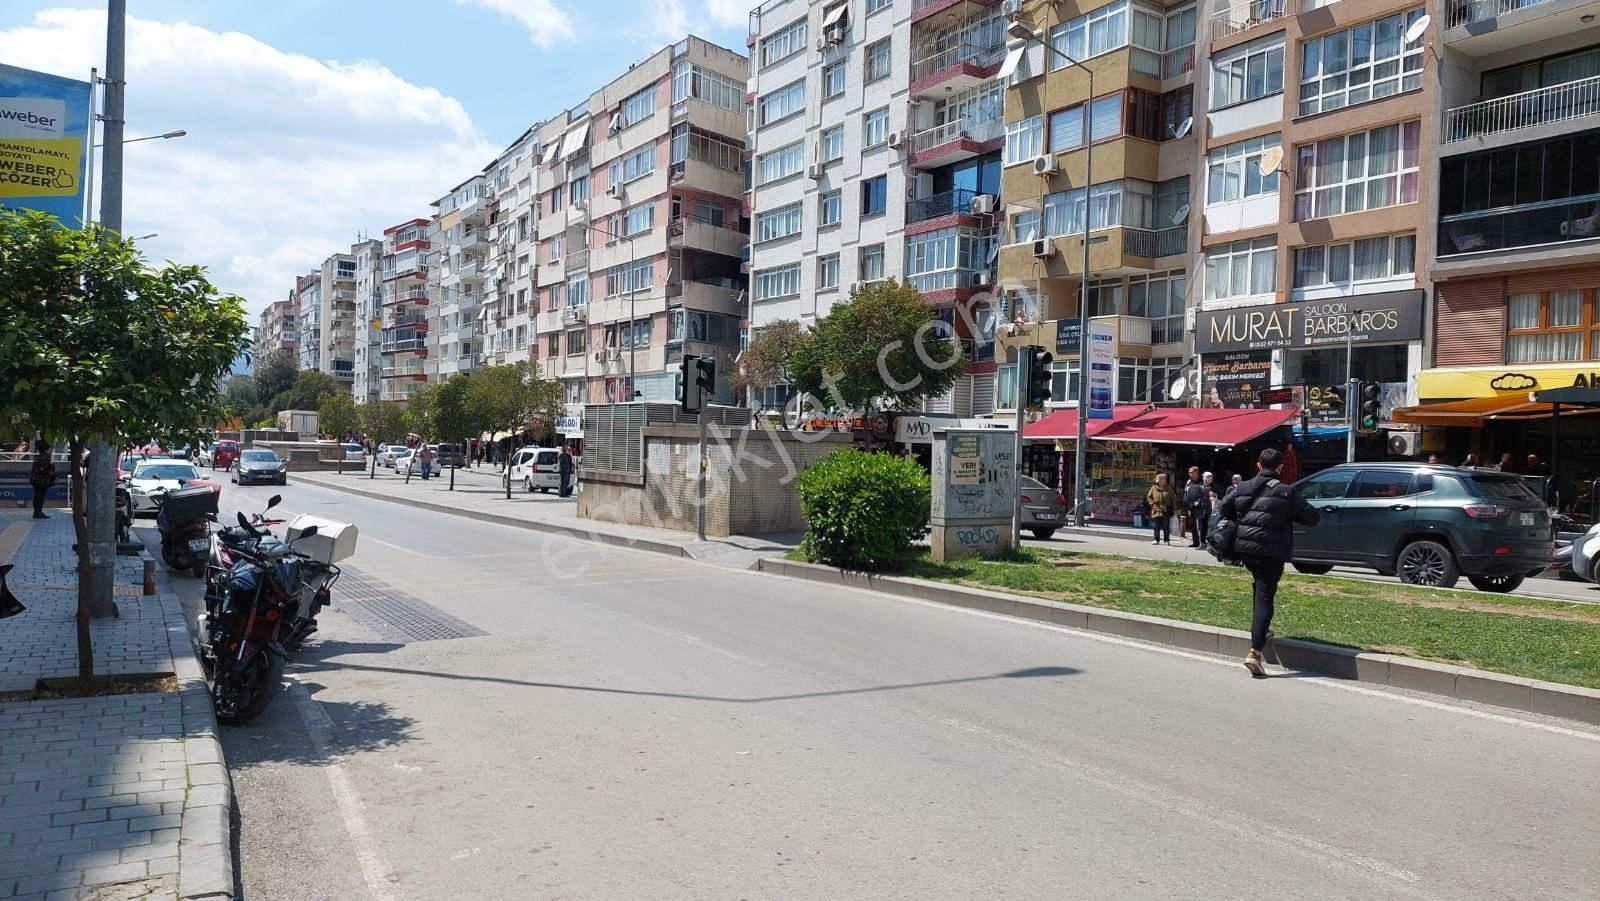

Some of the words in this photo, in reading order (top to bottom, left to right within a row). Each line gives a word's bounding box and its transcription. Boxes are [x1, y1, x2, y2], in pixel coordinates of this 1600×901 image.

[0, 142, 70, 160] MANTOLAMAYI,
[0, 160, 57, 177] WEBER
[0, 170, 51, 188] ÇÖZER
[1304, 302, 1347, 317] SALOON
[1210, 307, 1300, 344] MURAT
[1304, 310, 1398, 337] BARBAROS
[1225, 353, 1250, 361] SALOON
[1203, 363, 1230, 374] Murat
[1231, 360, 1273, 373] Barbaros
[1207, 374, 1219, 382] SAÇ
[1239, 370, 1266, 380] MERKEZİ
[1573, 373, 1600, 388] Al
[906, 420, 931, 436] MAD
